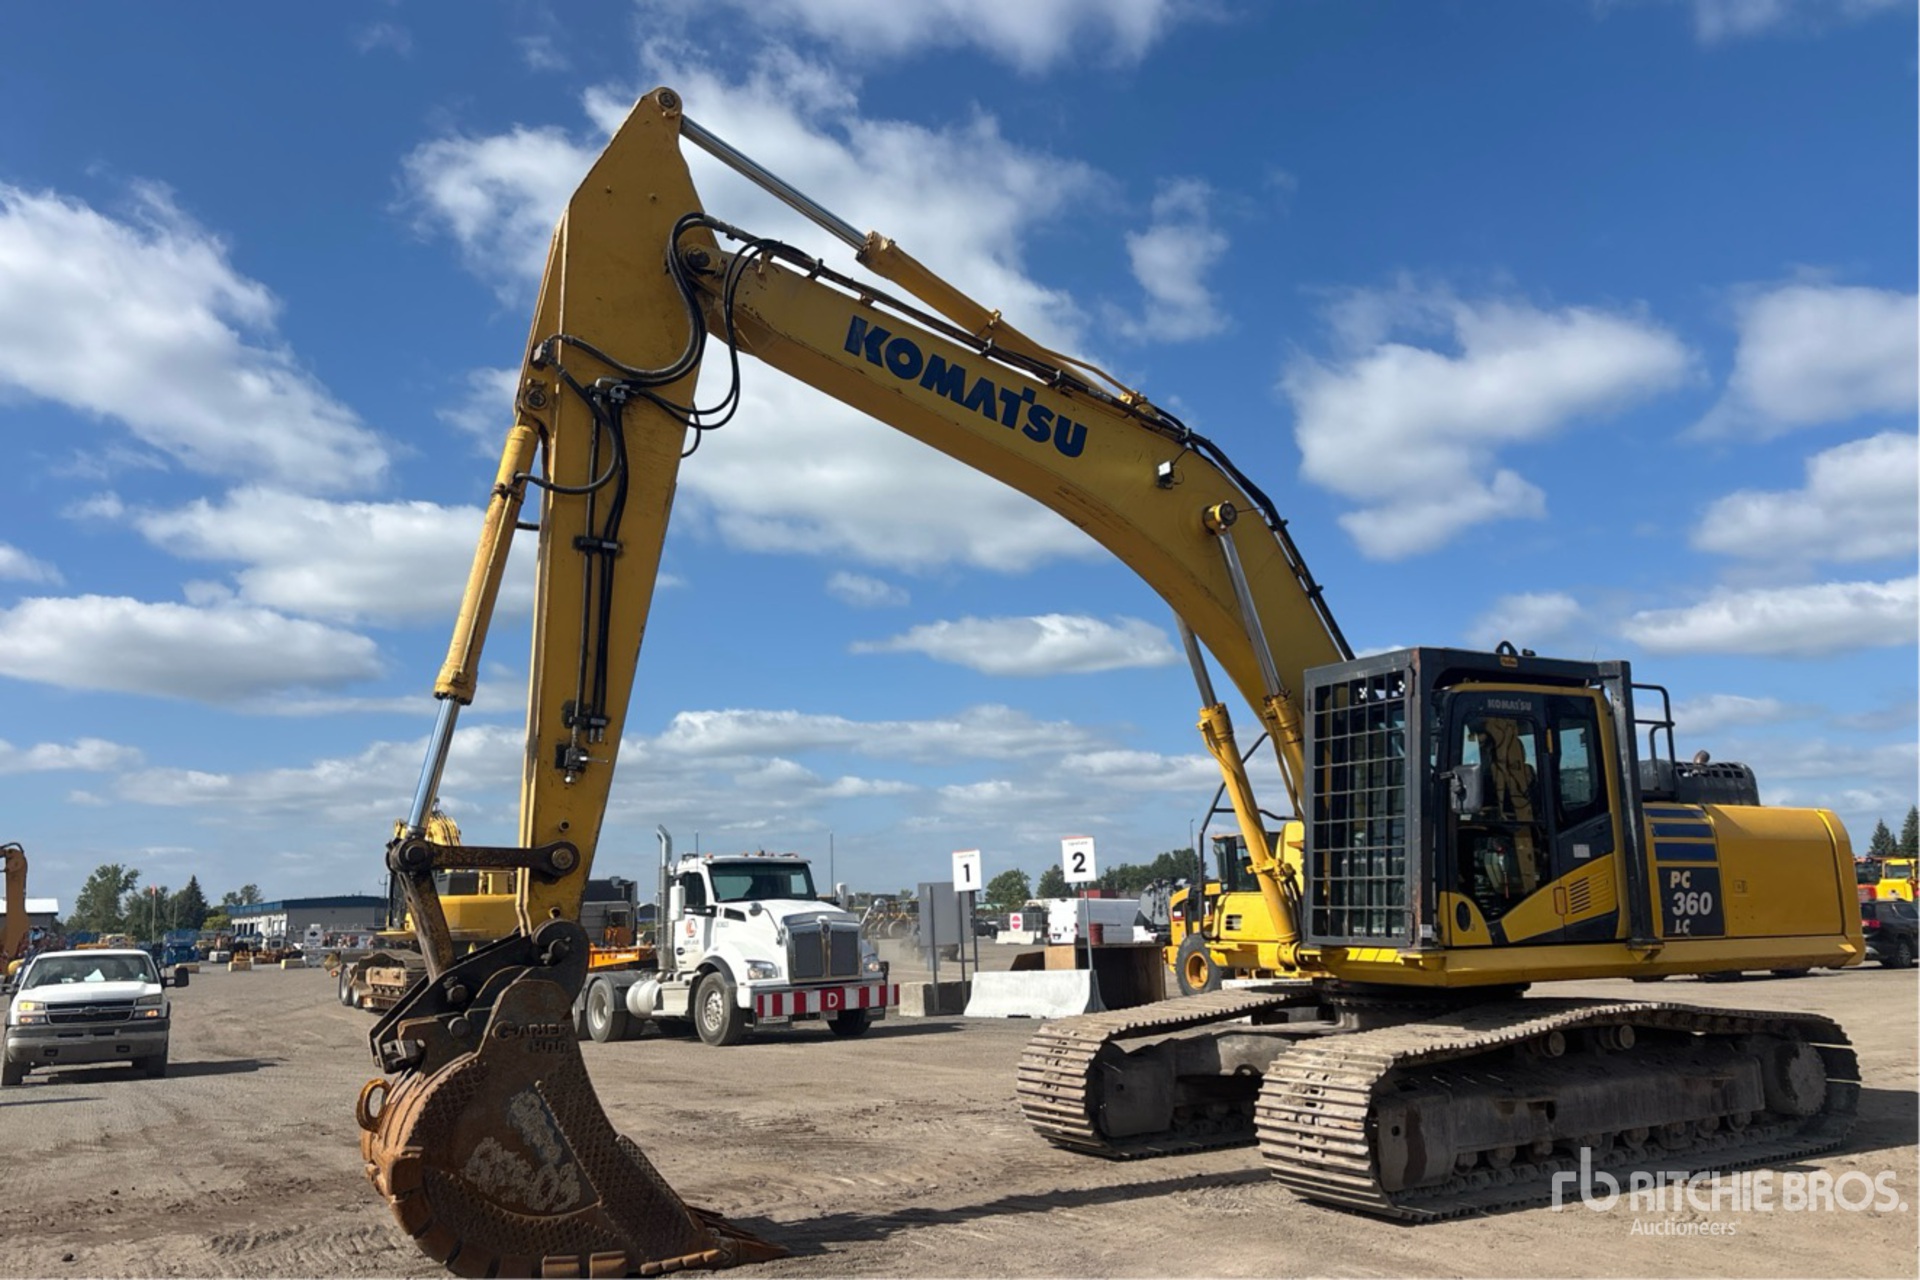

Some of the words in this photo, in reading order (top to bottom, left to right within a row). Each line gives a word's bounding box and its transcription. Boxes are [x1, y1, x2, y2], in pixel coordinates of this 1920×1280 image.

[844, 315, 1088, 458] KOMATSU
[1487, 698, 1532, 711] KOMATSU
[1072, 851, 1087, 873] 2
[963, 863, 970, 883] 1
[1670, 870, 1691, 889] PC
[1672, 891, 1713, 916] 360
[1674, 919, 1691, 934] LC
[827, 992, 839, 1008] D
